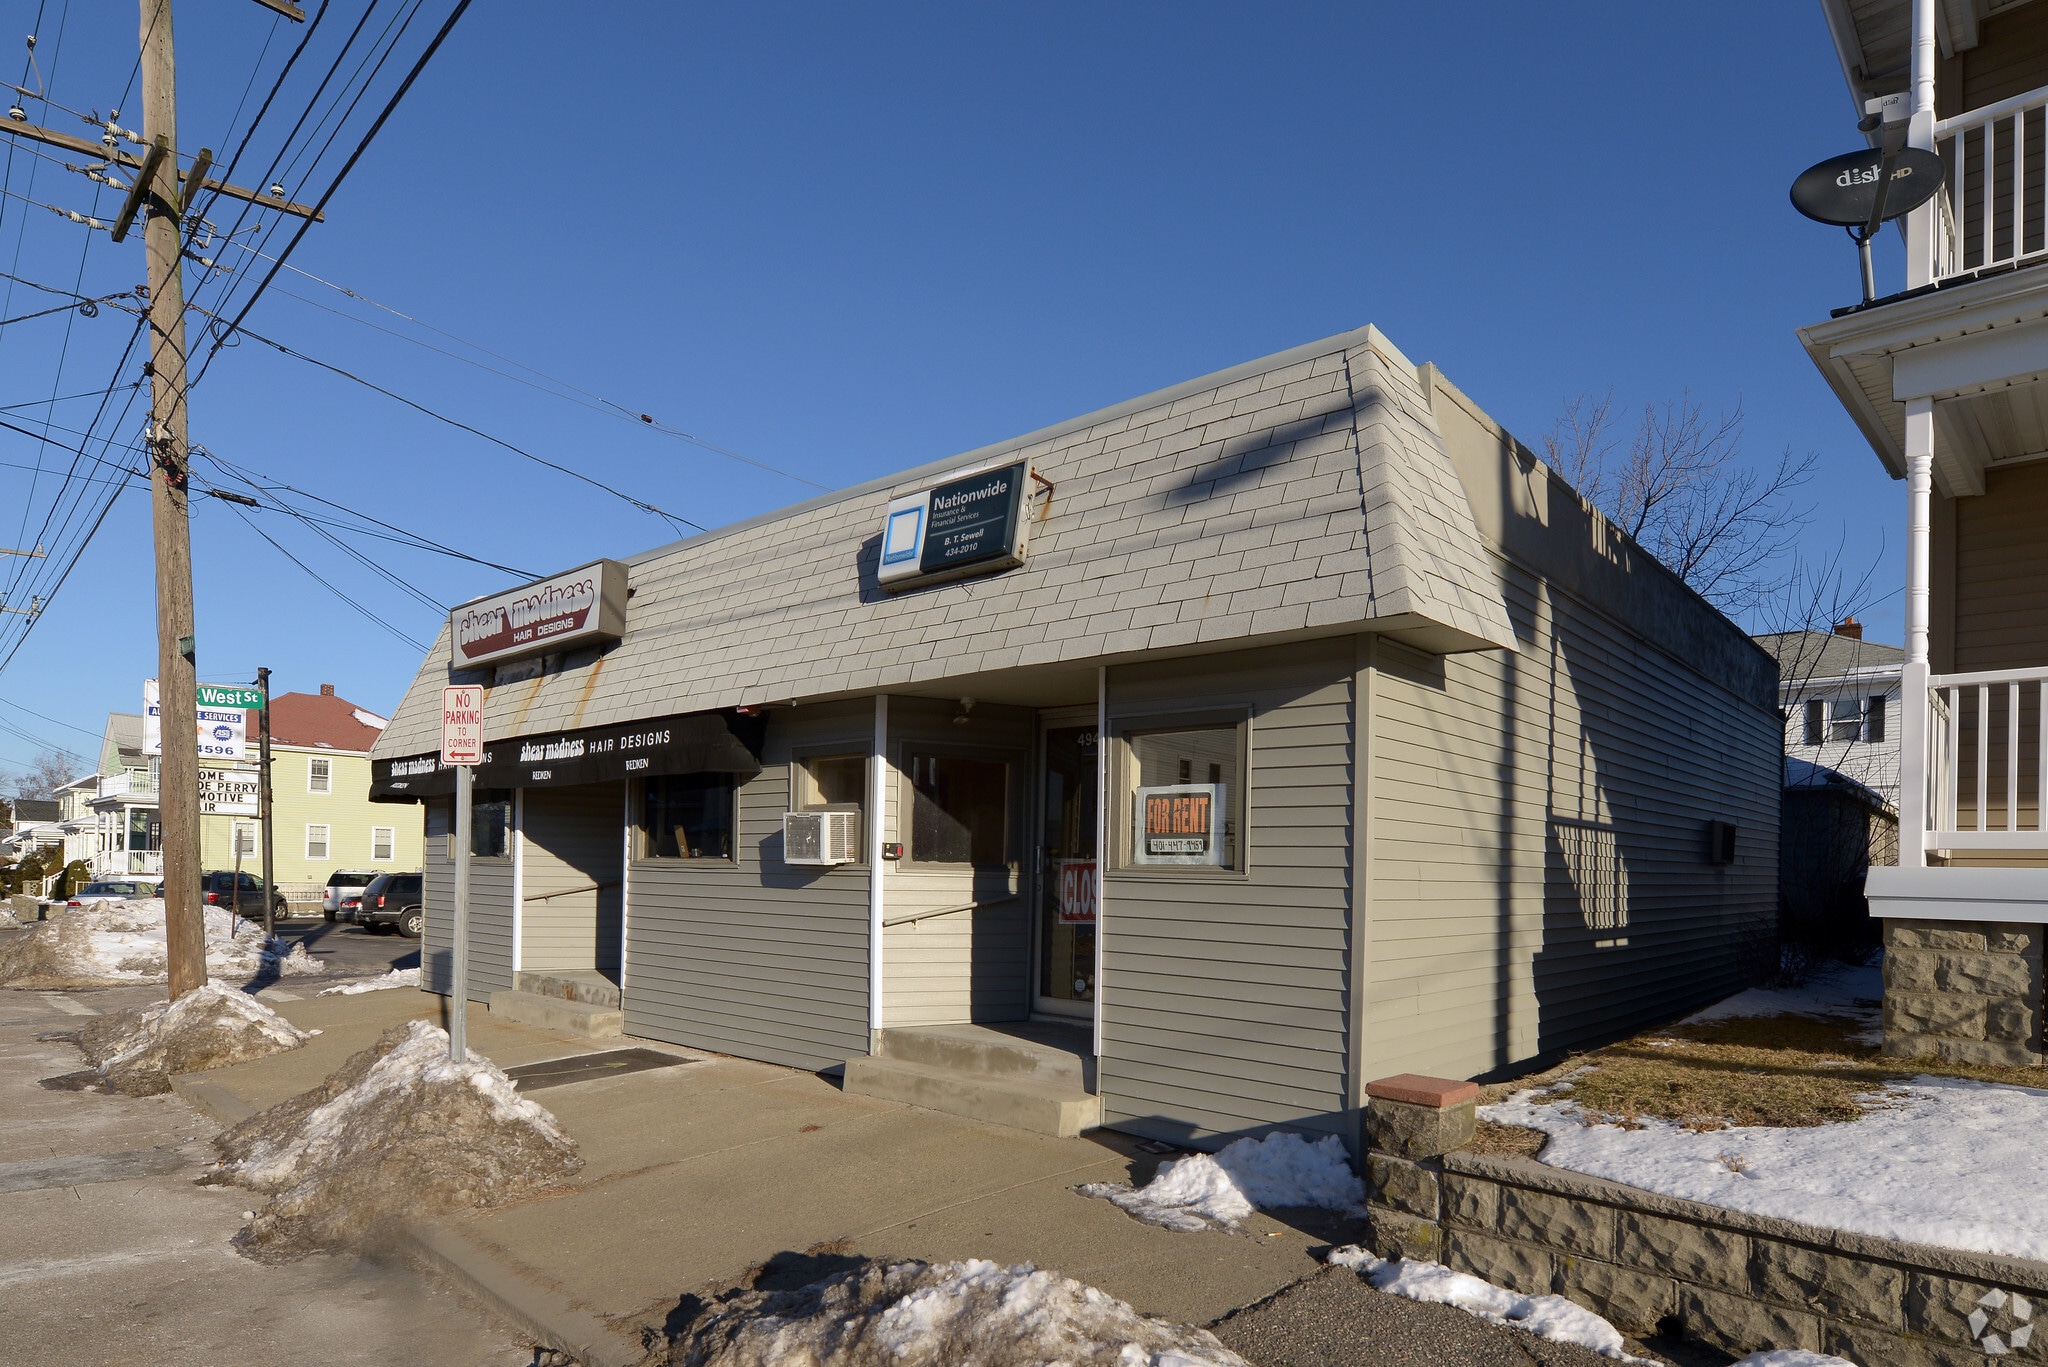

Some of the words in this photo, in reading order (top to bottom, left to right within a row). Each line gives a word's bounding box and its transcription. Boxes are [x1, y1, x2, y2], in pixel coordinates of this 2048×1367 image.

[933, 480, 1008, 511] Nationwide
[931, 517, 956, 529] Financial
[956, 511, 980, 523] Services
[932, 507, 960, 520] Insurance
[944, 537, 952, 546] B.
[953, 534, 960, 544] T.
[960, 528, 985, 542] Sewell
[885, 550, 915, 563] Nationwide
[944, 542, 979, 557] 434-2010
[459, 605, 505, 646] shear
[512, 578, 595, 629] madness
[513, 629, 533, 643] HAIR
[537, 617, 574, 636] DESIGNS
[201, 688, 242, 705] West
[244, 691, 259, 703] St
[455, 693, 471, 708] NO
[204, 713, 239, 722] SERVICES
[445, 710, 480, 725] PARKING
[457, 727, 467, 736] TO
[448, 738, 477, 748] CORNER
[520, 742, 545, 762] shear
[545, 738, 585, 760] madness
[589, 739, 614, 754] HAIR
[620, 729, 671, 750] DESIGNS
[625, 758, 649, 771] REDKEN
[532, 770, 552, 780] REDKEN
[217, 782, 257, 793] PERRY
[1146, 798, 1170, 834] FOR
[1172, 797, 1209, 833] RENT
[1062, 869, 1097, 915] CLOS
